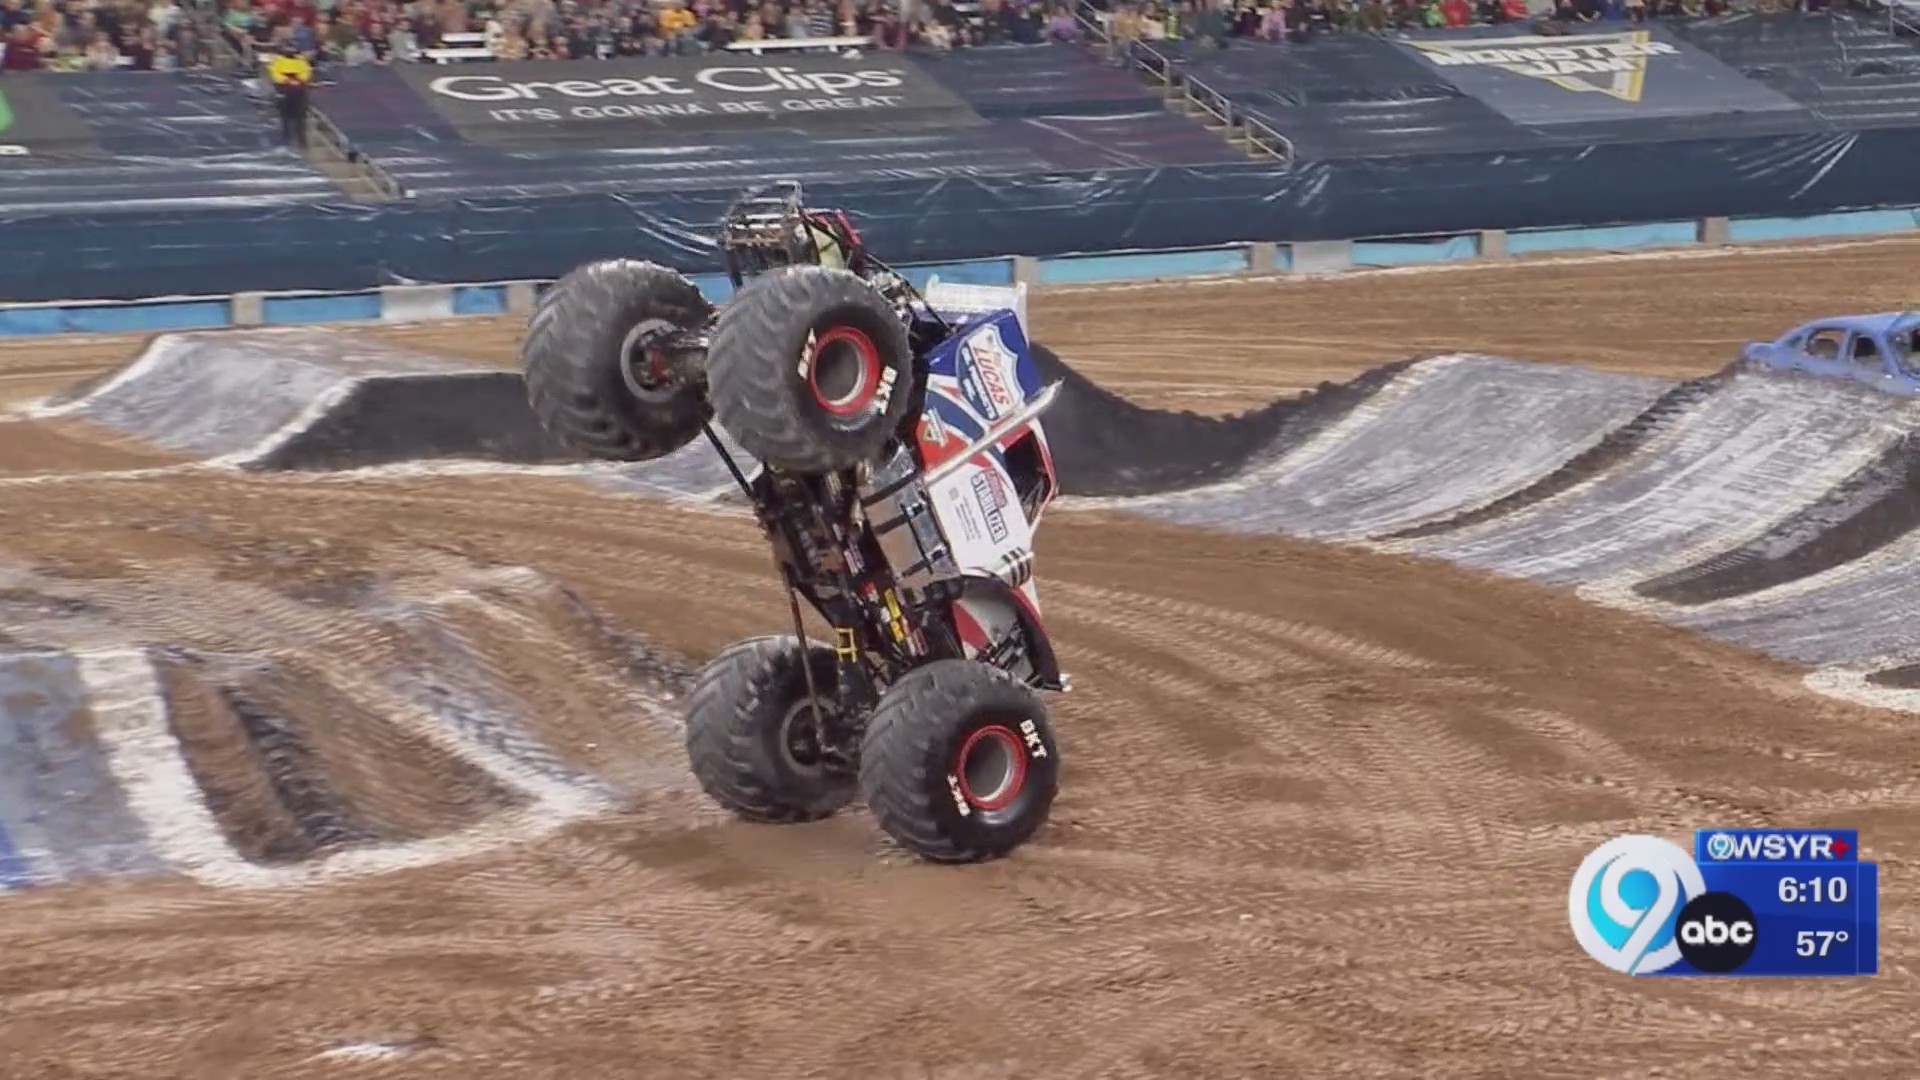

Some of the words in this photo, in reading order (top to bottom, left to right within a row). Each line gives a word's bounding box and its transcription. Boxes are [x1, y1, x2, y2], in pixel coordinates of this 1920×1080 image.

[1422, 42, 1681, 65] MONSTER
[1528, 59, 1638, 75] JAM
[429, 75, 694, 101] Great
[695, 66, 904, 96] Clips
[489, 107, 562, 121] IT'S
[570, 103, 713, 119] GONNA
[718, 101, 774, 114] BE
[782, 96, 903, 112] GREAT
[974, 347, 1010, 406] LUCAS
[972, 471, 1007, 543] STABILIZER
[1020, 719, 1047, 758] BKT
